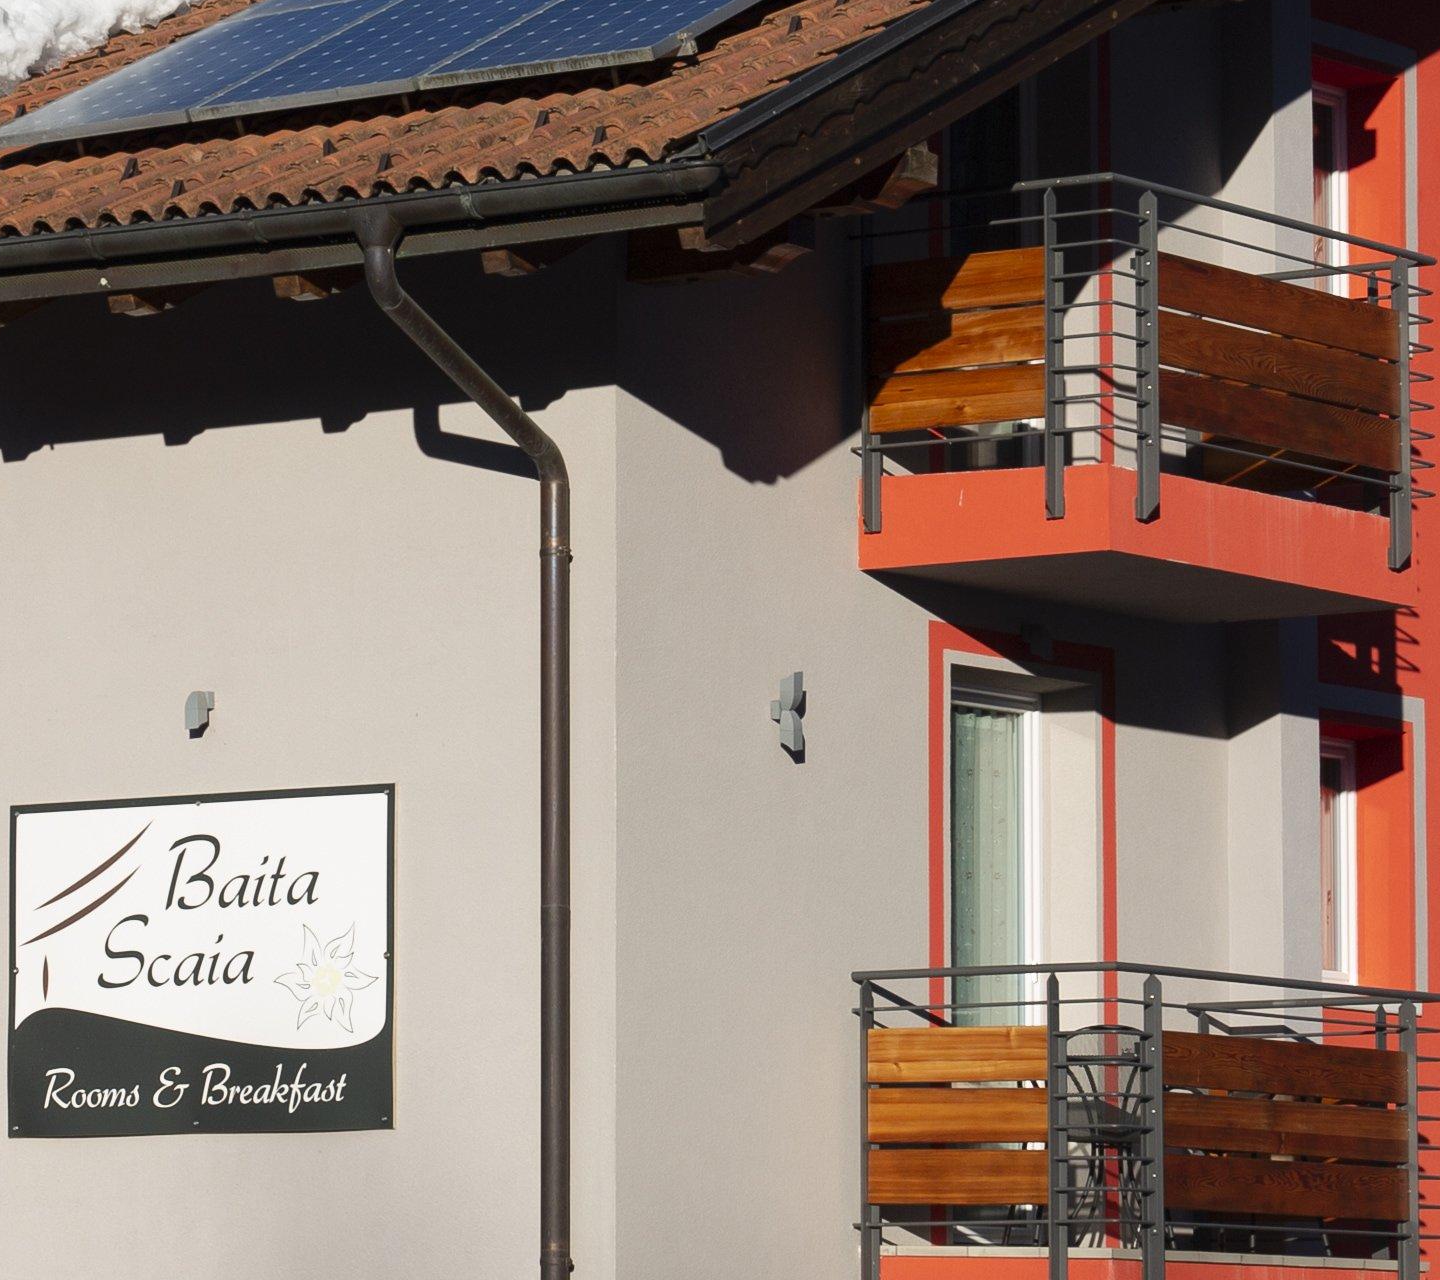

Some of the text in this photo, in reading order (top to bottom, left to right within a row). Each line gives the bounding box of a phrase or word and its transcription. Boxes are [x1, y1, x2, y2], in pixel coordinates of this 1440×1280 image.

[165, 833, 320, 911] Baita
[97, 914, 255, 989] Scaia
[43, 1062, 347, 1114] Rooms & Breakfast
